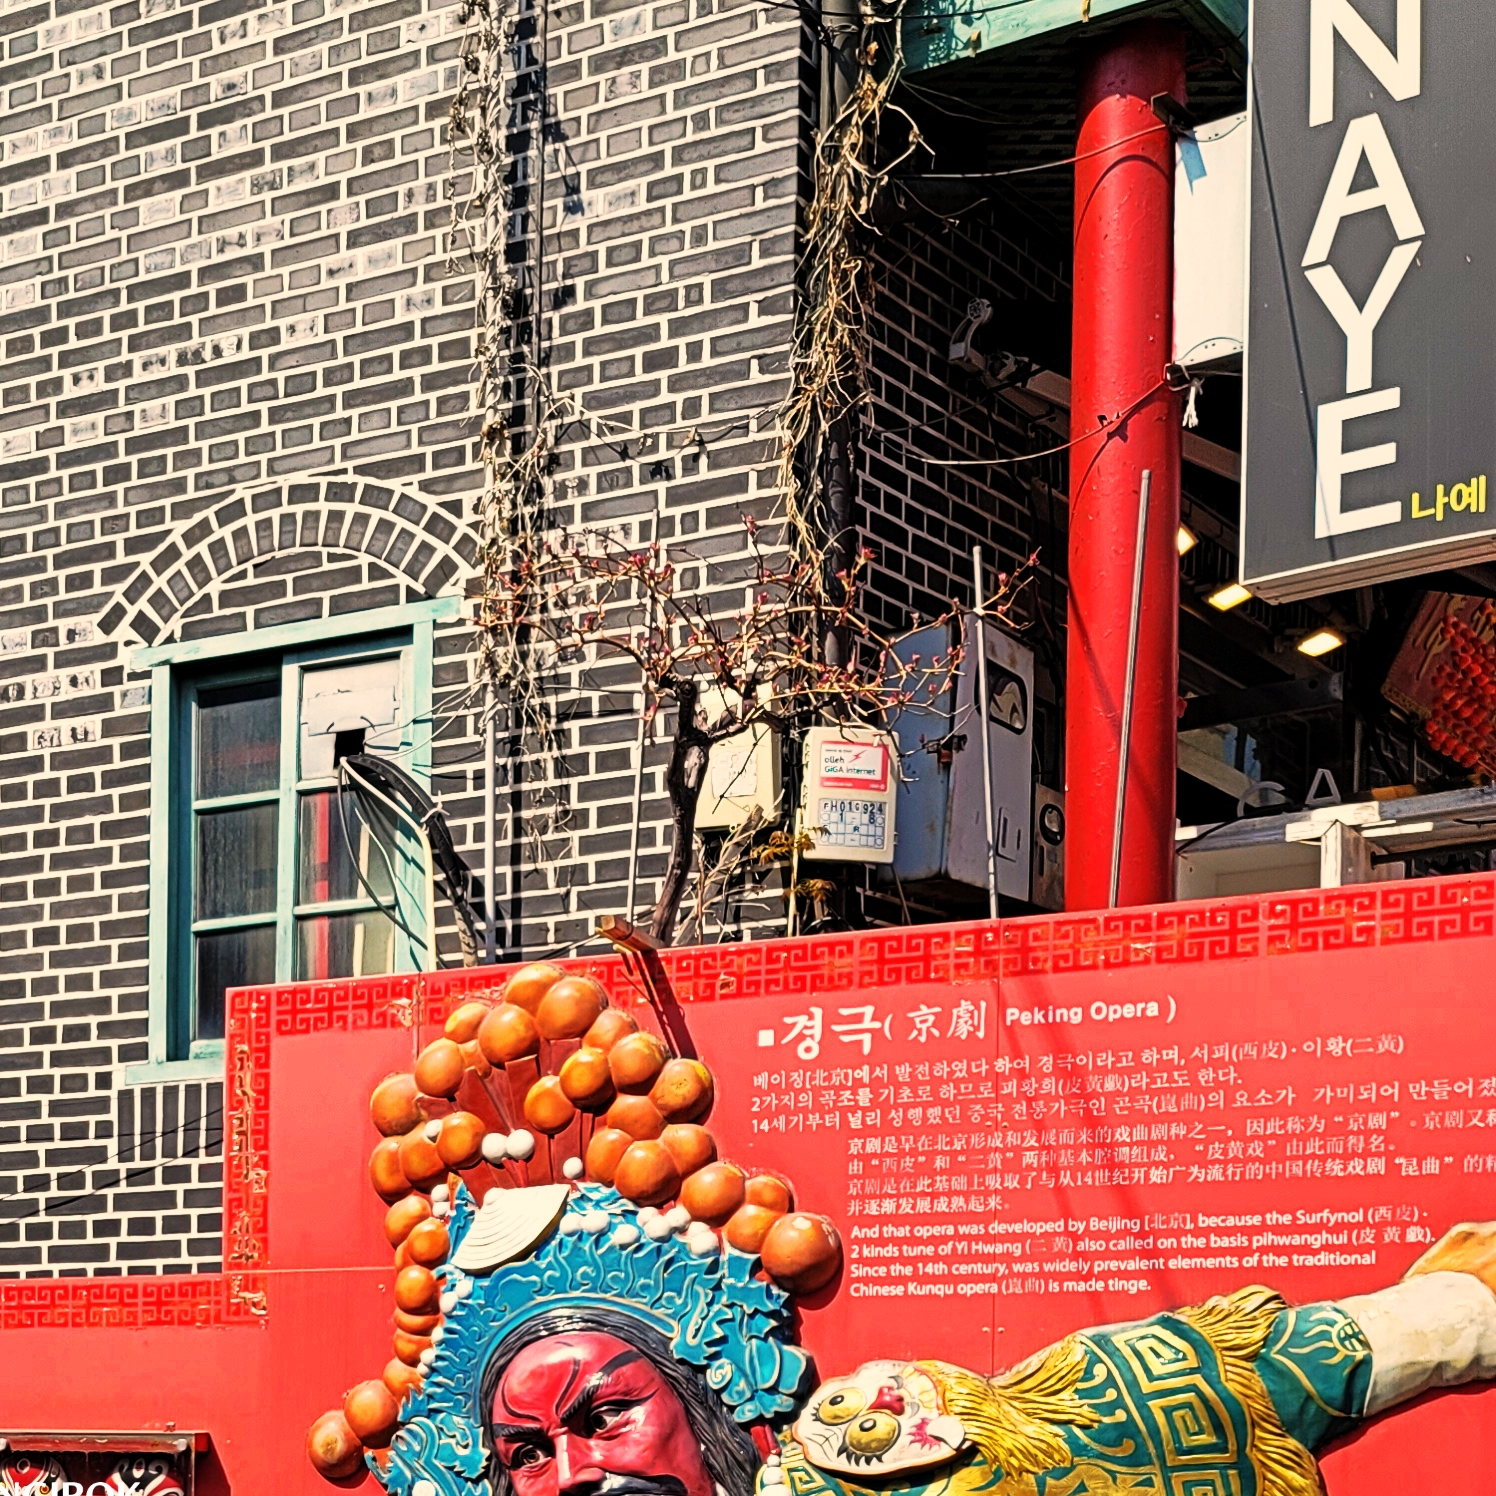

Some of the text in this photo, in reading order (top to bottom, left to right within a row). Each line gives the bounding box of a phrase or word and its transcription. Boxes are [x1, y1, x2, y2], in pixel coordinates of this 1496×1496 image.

[1301, 0, 1425, 539] NAYE
[1411, 475, 1487, 521] 나예
[1005, 1005, 1083, 1027] Peking
[895, 1058, 989, 1083] 발전하였다
[994, 1055, 1030, 1076] 하여
[1037, 1050, 1135, 1073] 경극이라고
[751, 1091, 813, 1112] 2가지의
[819, 1087, 874, 1109] 곡조를
[879, 1085, 934, 1105] 기초로
[939, 1081, 995, 1101] 하므로
[1198, 1065, 1243, 1086] 한다.
[752, 1111, 840, 1134] 14세기부터
[847, 1109, 882, 1129] 널리
[968, 1103, 1005, 1123] 중국
[1232, 1085, 1297, 1108] 요소가
[1313, 1081, 1399, 1105] 가미되어
[850, 1224, 880, 1239] And
[882, 1223, 911, 1238] that
[914, 1225, 954, 1239] opera
[957, 1223, 986, 1235] was
[988, 1218, 1064, 1236] developed
[1068, 1218, 1086, 1234] by
[1089, 1216, 1141, 1233] Beijing
[1198, 1212, 1263, 1227] because
[1265, 1210, 1293, 1225] the
[1295, 1208, 1363, 1227] Surfynol
[850, 1245, 860, 1258] 2
[863, 1243, 900, 1258] kinds
[902, 1244, 935, 1257] tune
[938, 1241, 954, 1255] of
[955, 1241, 968, 1255] Yi
[971, 1241, 1022, 1257] Hwang
[1076, 1236, 1106, 1252] also
[1109, 1235, 1154, 1250] called
[1157, 1237, 1177, 1249] on
[1181, 1234, 1207, 1249] the
[1210, 1233, 1249, 1248] basis
[1252, 1230, 1348, 1250] pihwanghui
[850, 1250, 1376, 1278] Since the 14th century, was widely prevalent elements of the traditional
[850, 1281, 905, 1297] Chinese
[907, 1281, 954, 1298] Kunqu
[957, 1283, 998, 1297] opera
[1048, 1278, 1060, 1292] is
[1063, 1277, 1105, 1292] made
[1108, 1277, 1152, 1294] tinge.
